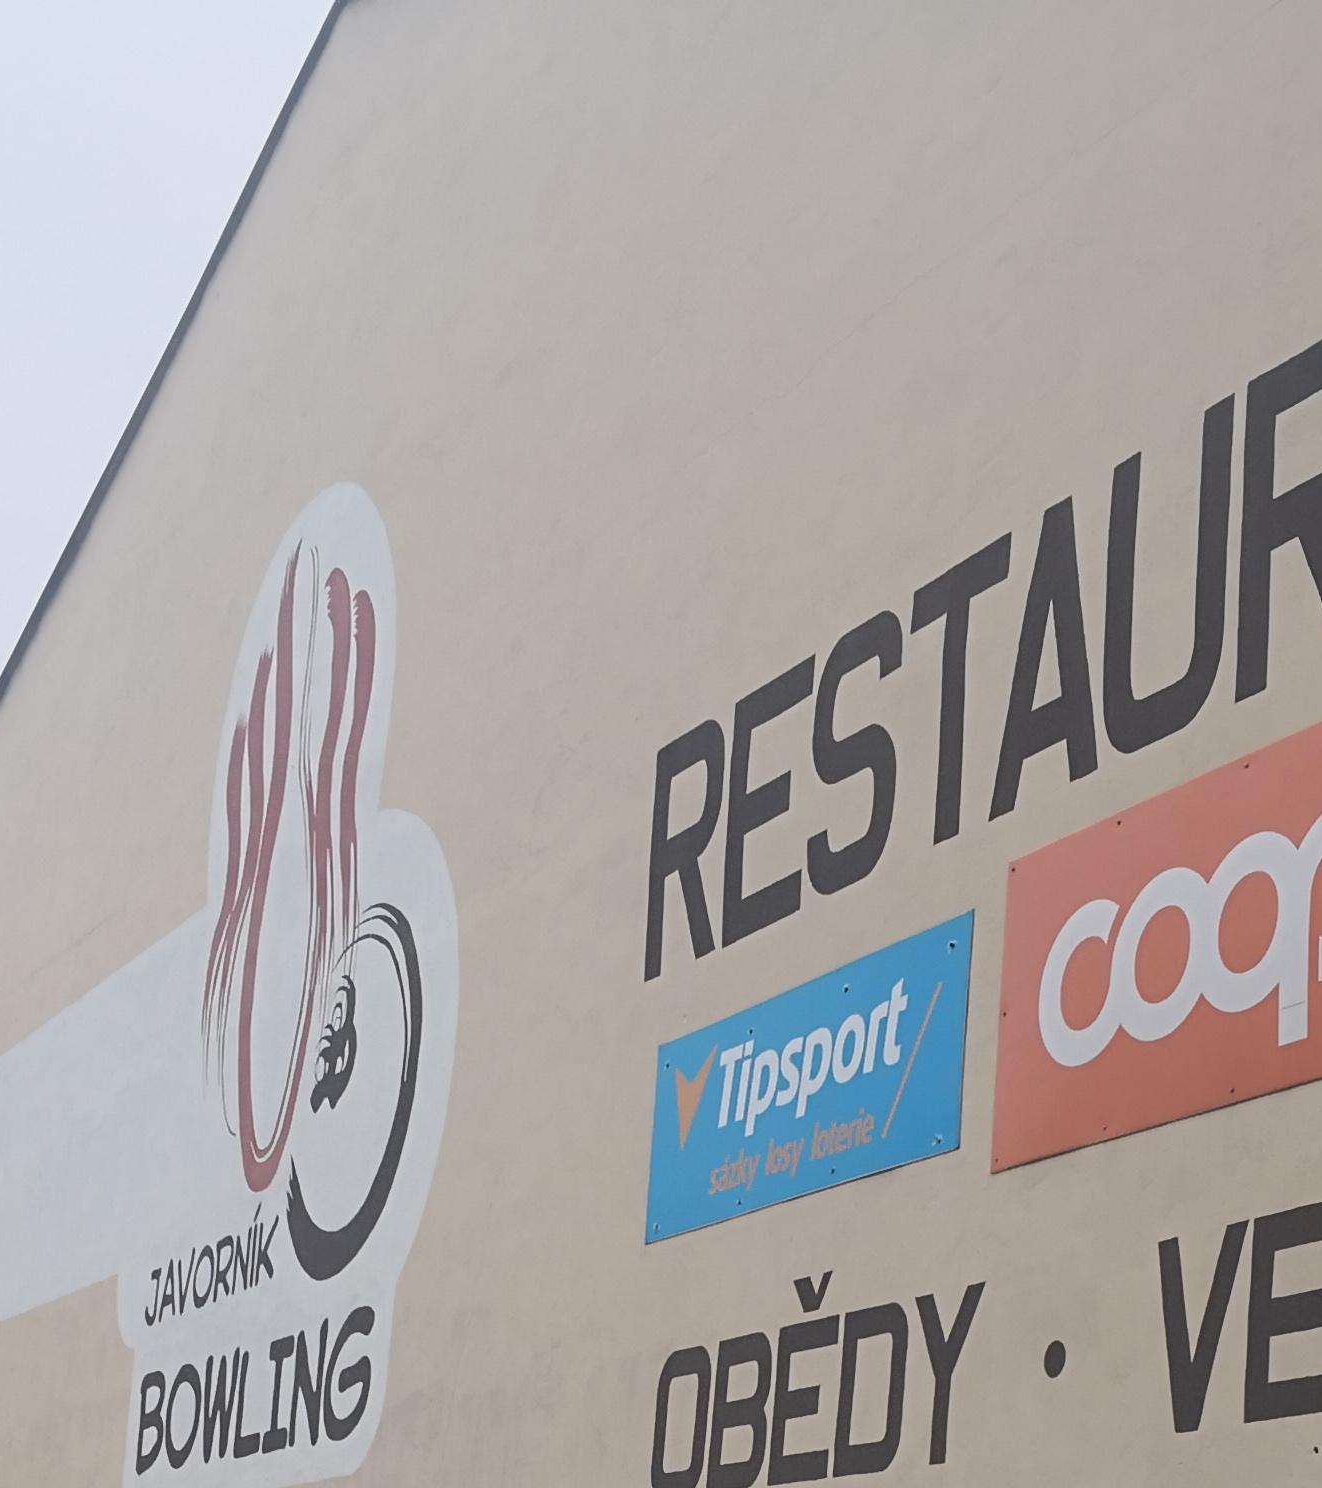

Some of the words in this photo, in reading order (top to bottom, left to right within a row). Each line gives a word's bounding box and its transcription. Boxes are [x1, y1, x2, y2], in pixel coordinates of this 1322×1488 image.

[718, 978, 908, 1137] Tipsport
[145, 1202, 279, 1326] JAVORNÍK
[136, 1305, 375, 1475] BOWLING
